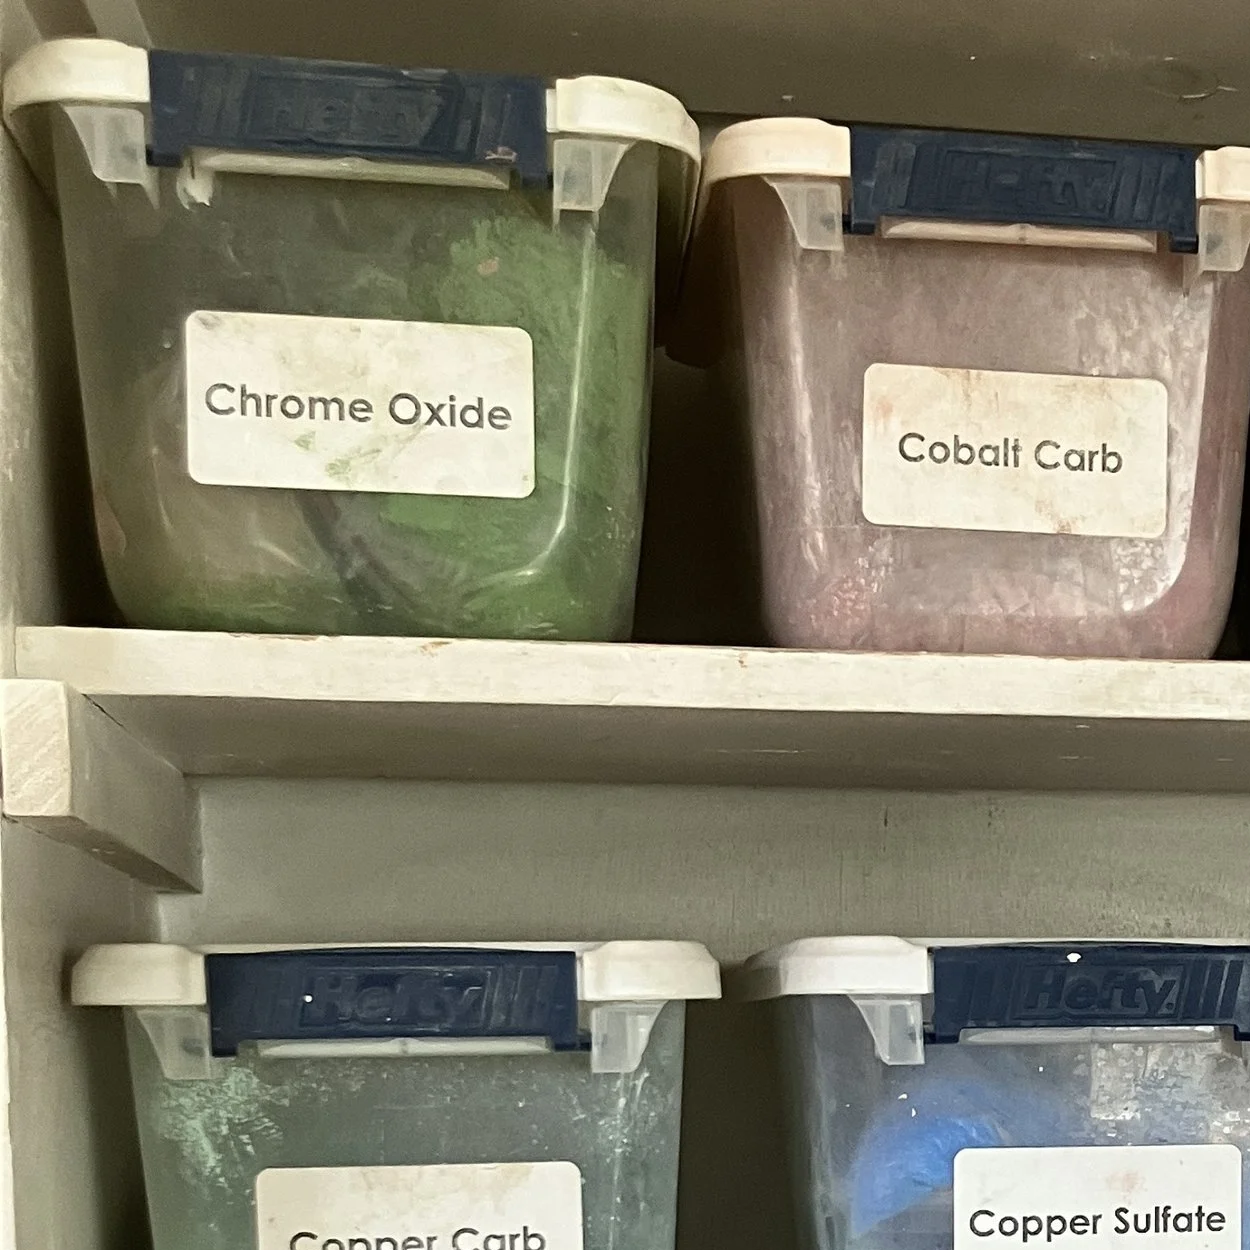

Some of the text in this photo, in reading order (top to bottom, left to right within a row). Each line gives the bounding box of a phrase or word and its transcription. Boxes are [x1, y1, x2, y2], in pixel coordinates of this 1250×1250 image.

[205, 383, 512, 431] Chrome Oxide
[897, 431, 1123, 474] Cobalt Carb
[1022, 967, 1177, 1014] Hefty
[967, 1205, 1227, 1244] Copper Sulfate
